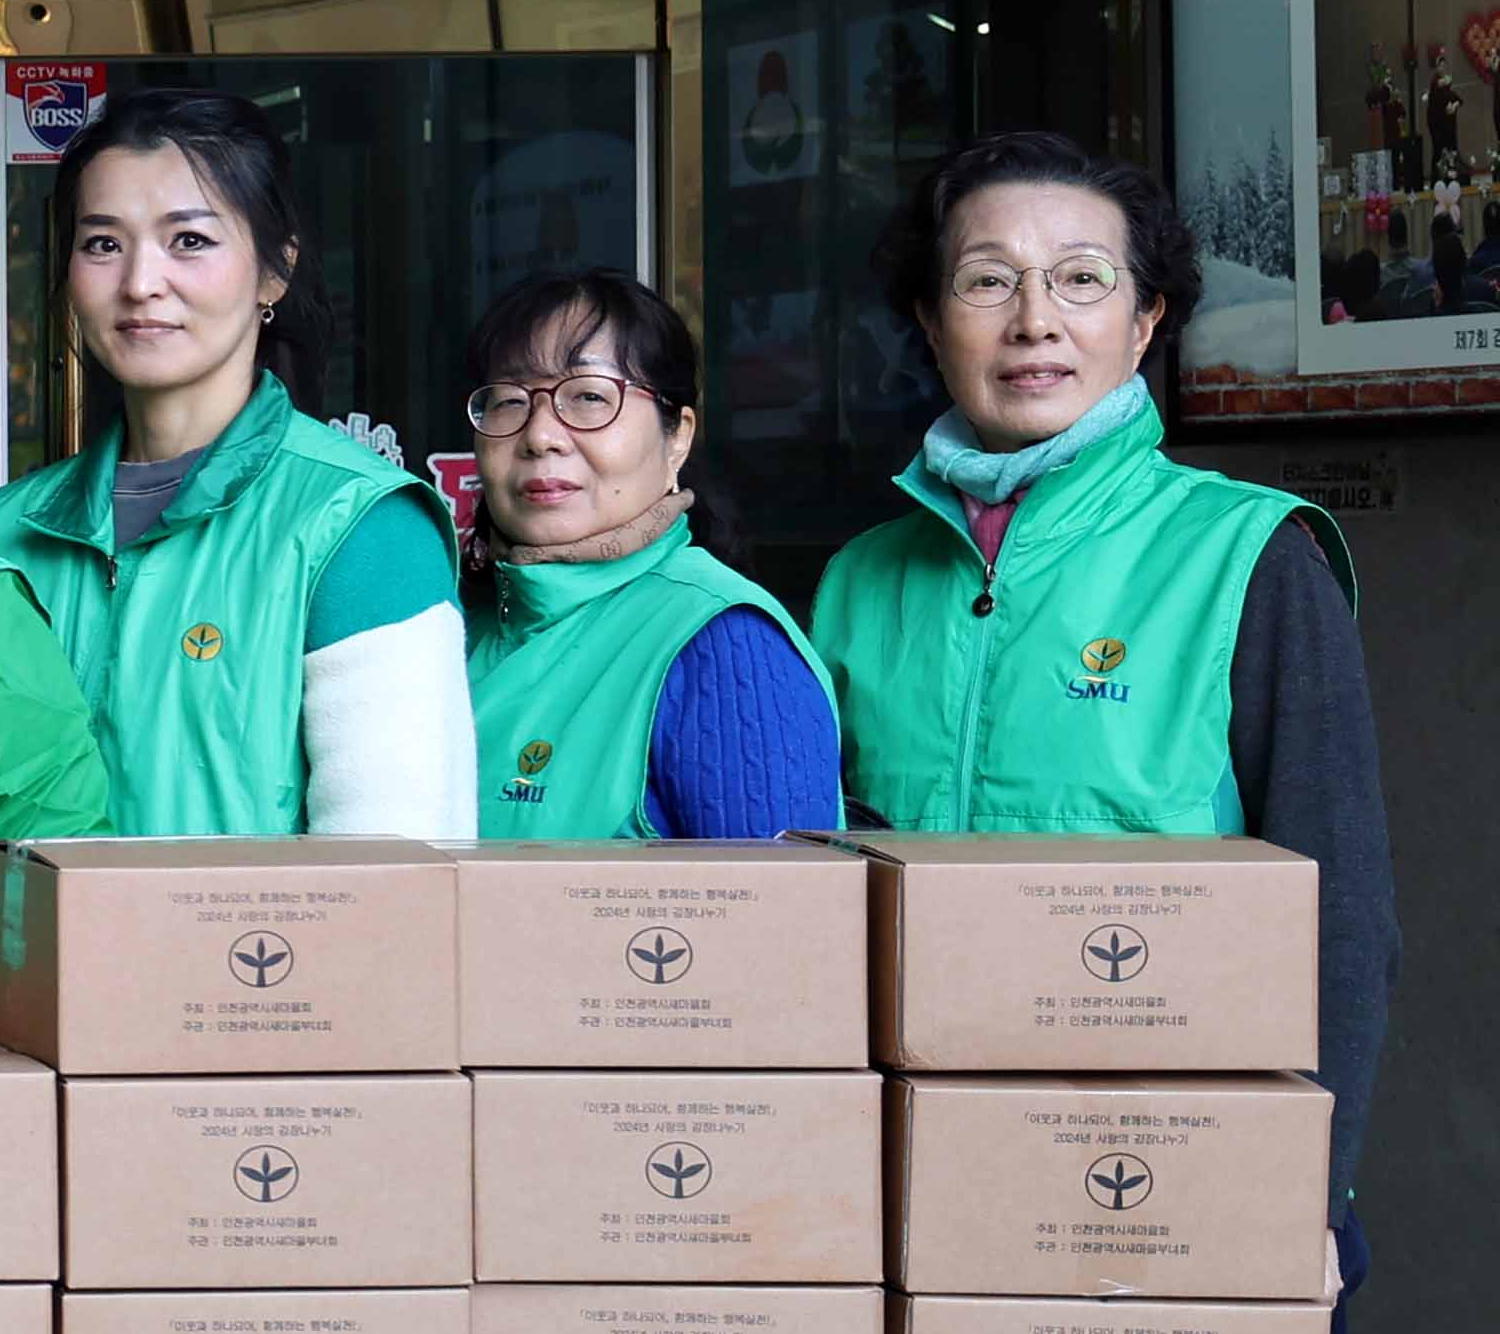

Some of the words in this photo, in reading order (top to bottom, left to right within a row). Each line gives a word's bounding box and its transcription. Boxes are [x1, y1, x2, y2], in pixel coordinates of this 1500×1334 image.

[16, 66, 55, 78] CCTV
[31, 108, 83, 127] BOSS
[1066, 681, 1129, 703] SMU
[498, 784, 546, 803] SMU
[1053, 1132, 1092, 1145] 2024년
